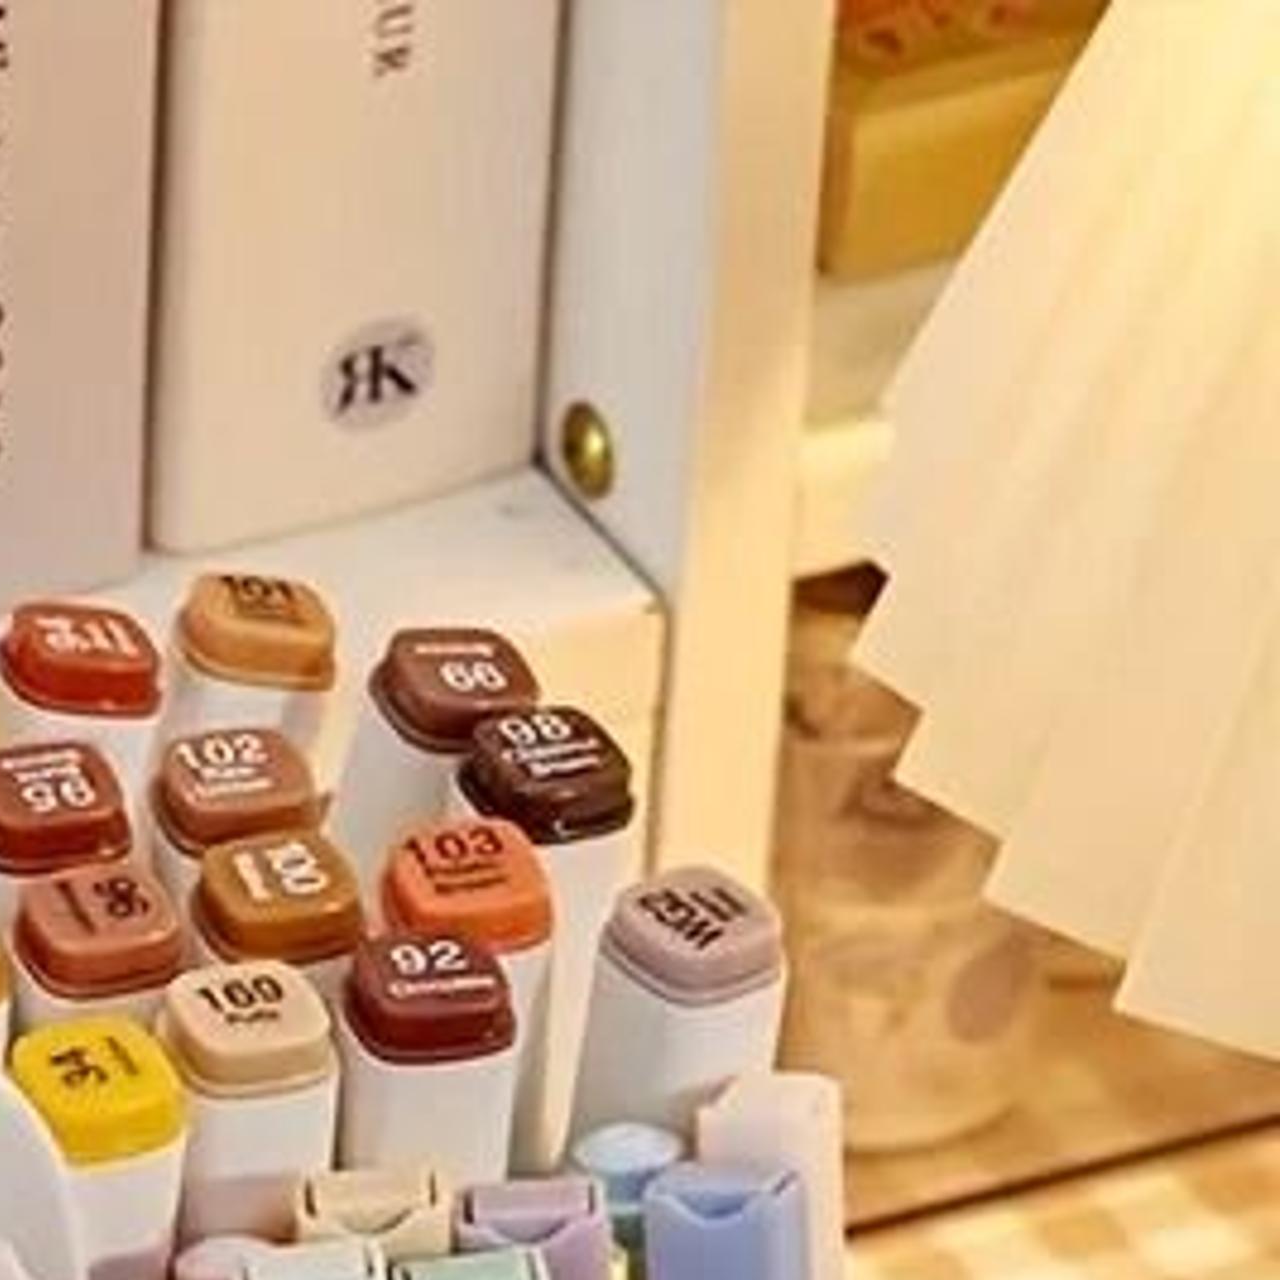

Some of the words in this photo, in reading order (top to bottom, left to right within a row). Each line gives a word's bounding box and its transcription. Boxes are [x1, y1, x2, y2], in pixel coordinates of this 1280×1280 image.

[497, 709, 571, 747] 98
[172, 733, 267, 769] 102
[403, 825, 504, 867] 103
[389, 939, 467, 974] 92
